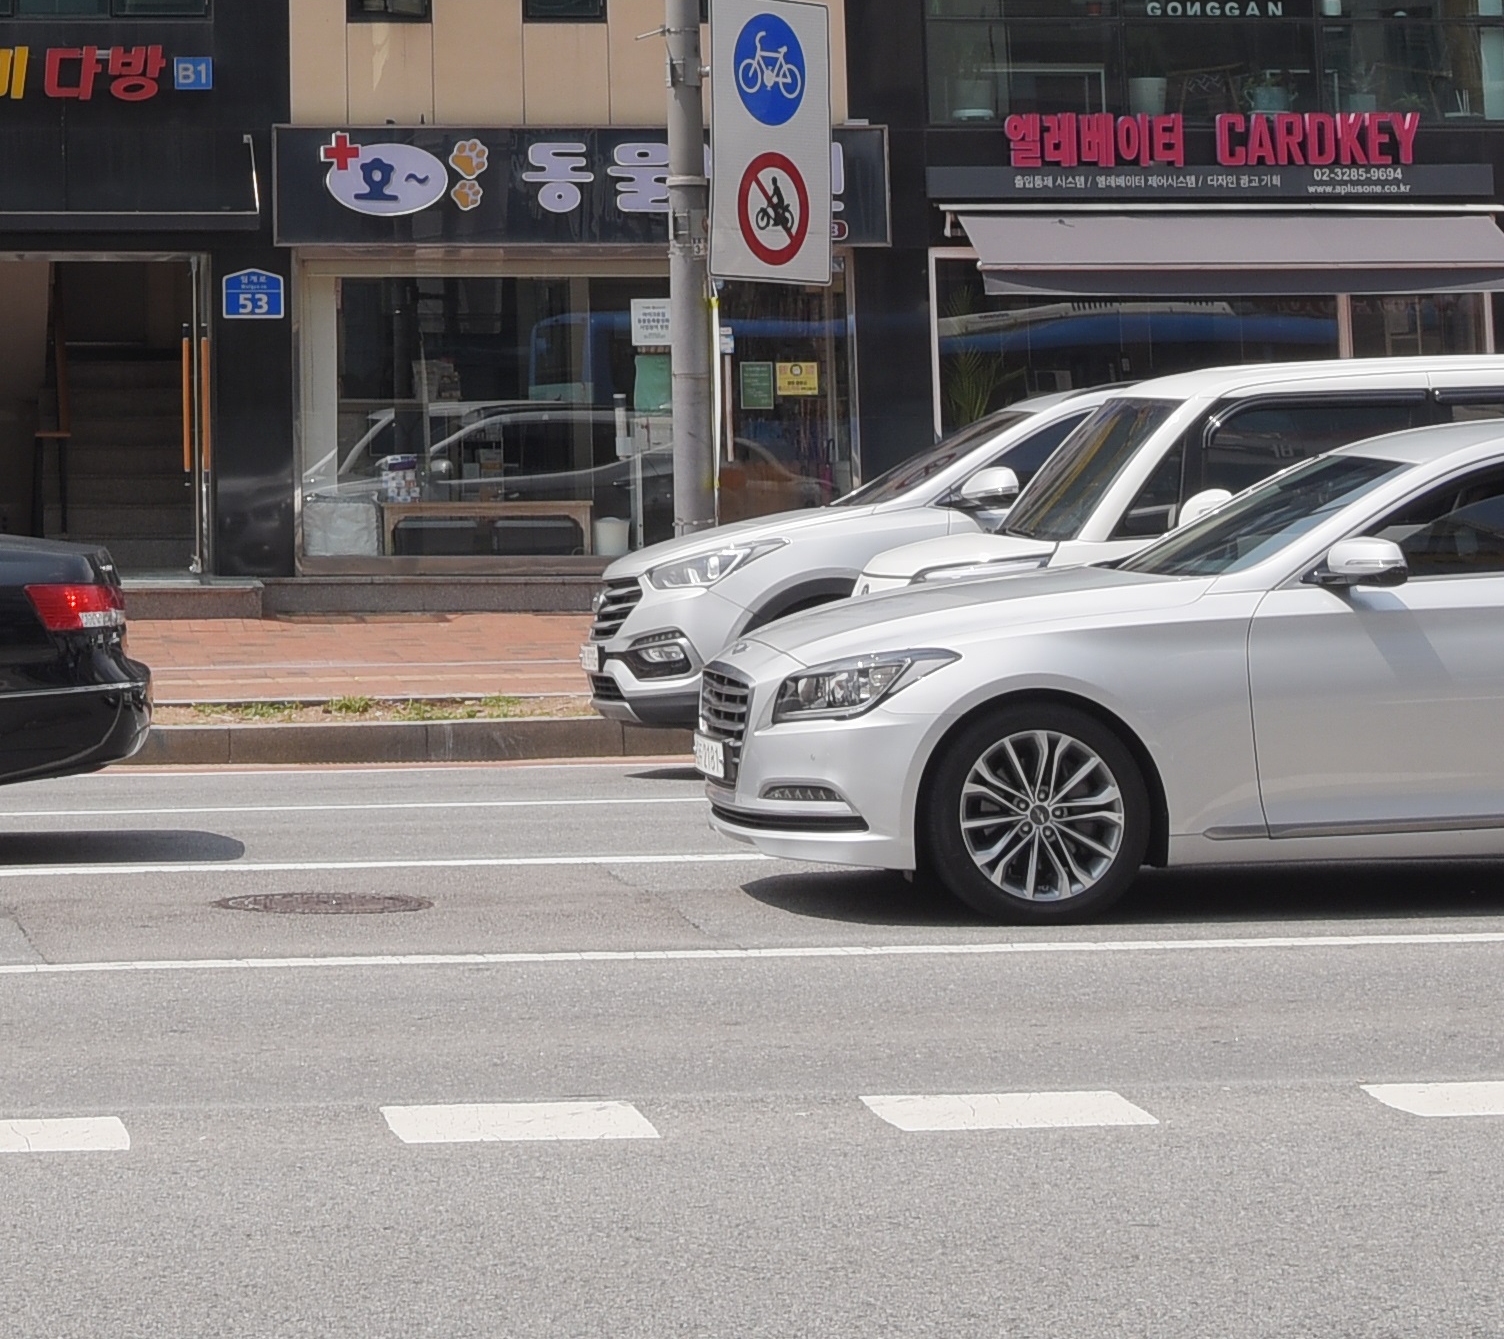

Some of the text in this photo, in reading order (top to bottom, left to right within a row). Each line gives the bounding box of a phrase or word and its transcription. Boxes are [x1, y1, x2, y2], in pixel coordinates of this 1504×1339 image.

[178, 62, 210, 86] B1
[1004, 111, 1421, 168] 엘레베이터 CARDKEY
[1313, 167, 1403, 181] 02-3285-9694
[1306, 183, 1412, 196] www.aplusone.co.kr
[238, 293, 269, 314] 53
